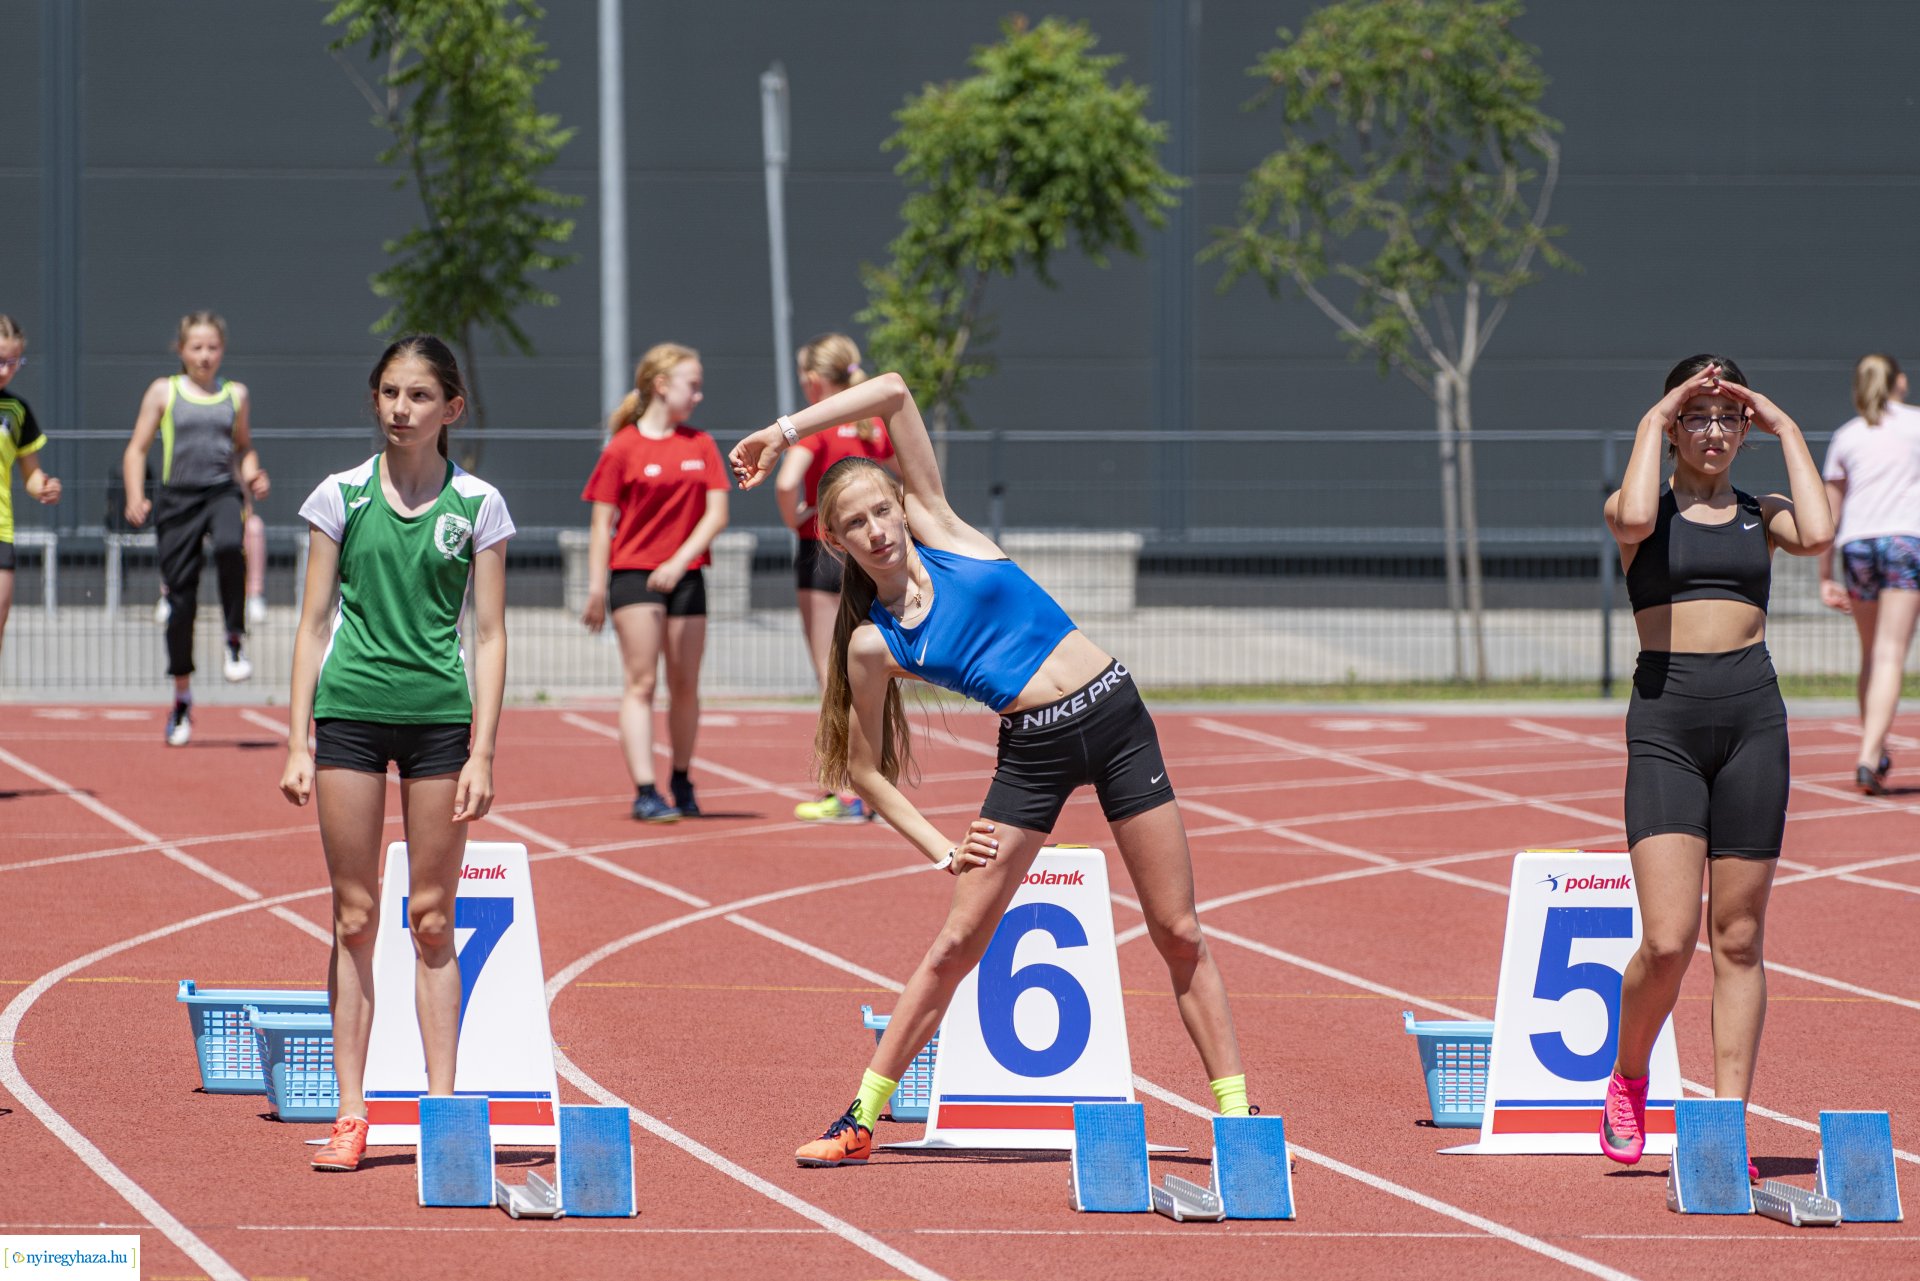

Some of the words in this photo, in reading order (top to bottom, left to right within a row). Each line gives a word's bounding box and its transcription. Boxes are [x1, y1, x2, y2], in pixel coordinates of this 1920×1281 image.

[1023, 692, 1087, 729] NIKE
[1088, 662, 1128, 703] PRO
[459, 864, 507, 879] lanik
[1565, 874, 1631, 893] polanik
[402, 897, 514, 1073] 7
[977, 902, 1091, 1078] 6
[1529, 907, 1633, 1082] 5
